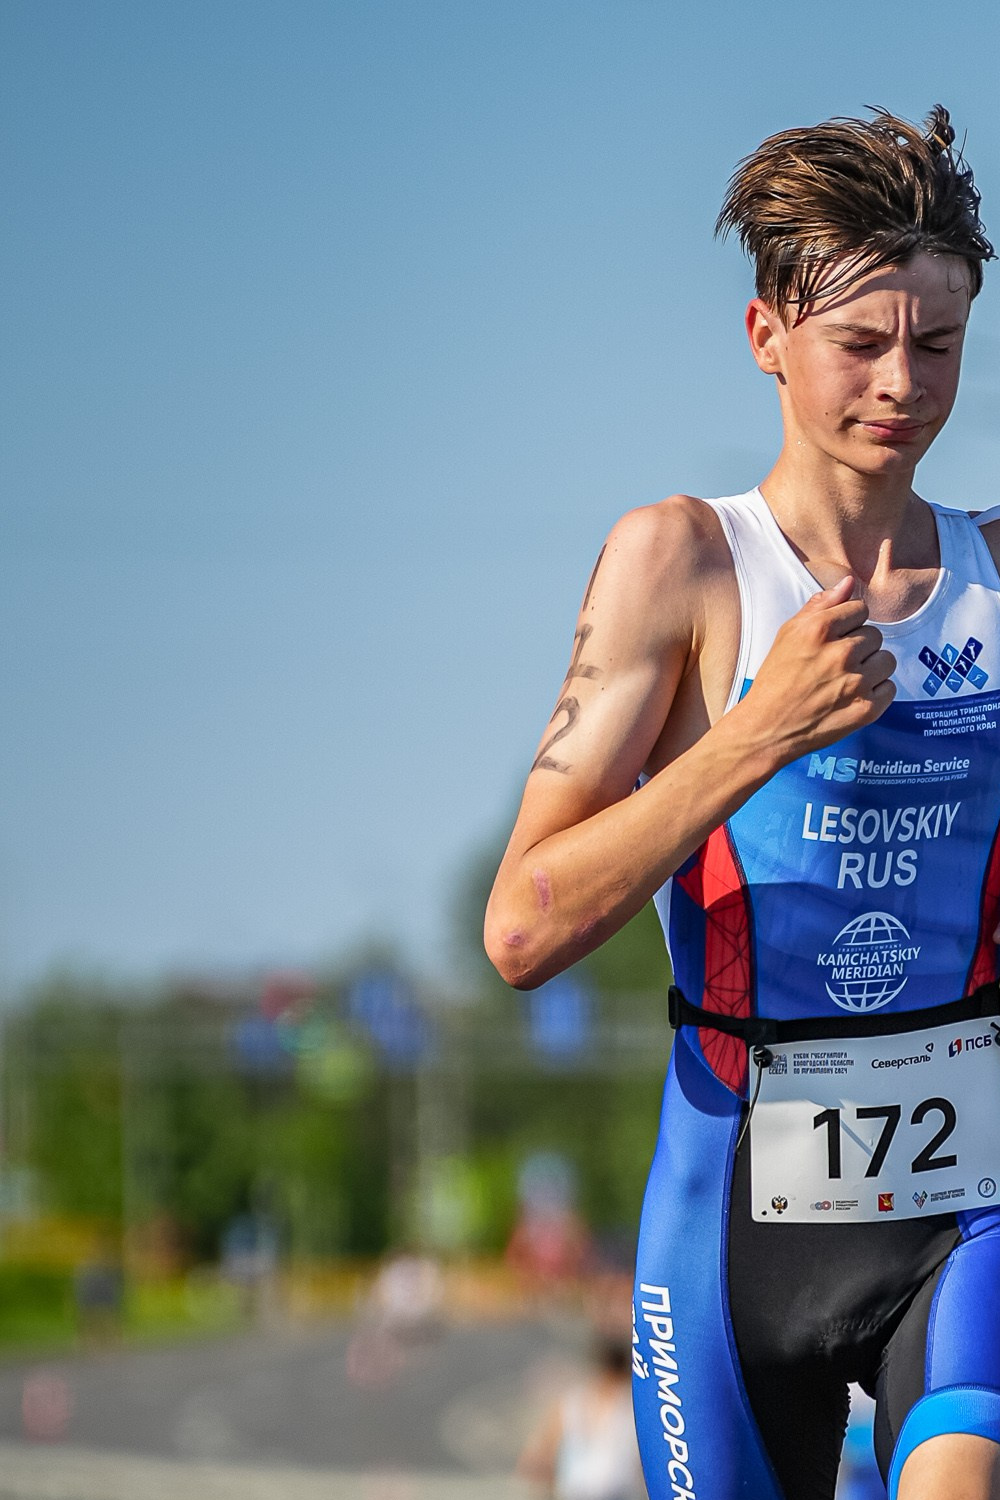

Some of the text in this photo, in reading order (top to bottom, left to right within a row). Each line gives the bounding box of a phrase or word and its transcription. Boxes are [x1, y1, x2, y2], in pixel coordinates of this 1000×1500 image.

[915, 709, 958, 720] ФЕДЕРАЦИЯ
[932, 713, 987, 728] И ПОЛИАТЛОНА
[923, 721, 997, 737] ПРИМОРСКОГО КРАЯ
[806, 753, 858, 783] MS
[859, 756, 970, 775] Meridian Service
[802, 801, 962, 844] LESOVSKIY
[836, 849, 918, 889] RUS
[817, 946, 921, 966] KAMCHATSKIY
[831, 962, 904, 980] MERIDIAN
[965, 1034, 992, 1052] ПСБ
[871, 1053, 931, 1070] Северсталь
[813, 1097, 957, 1179] 172
